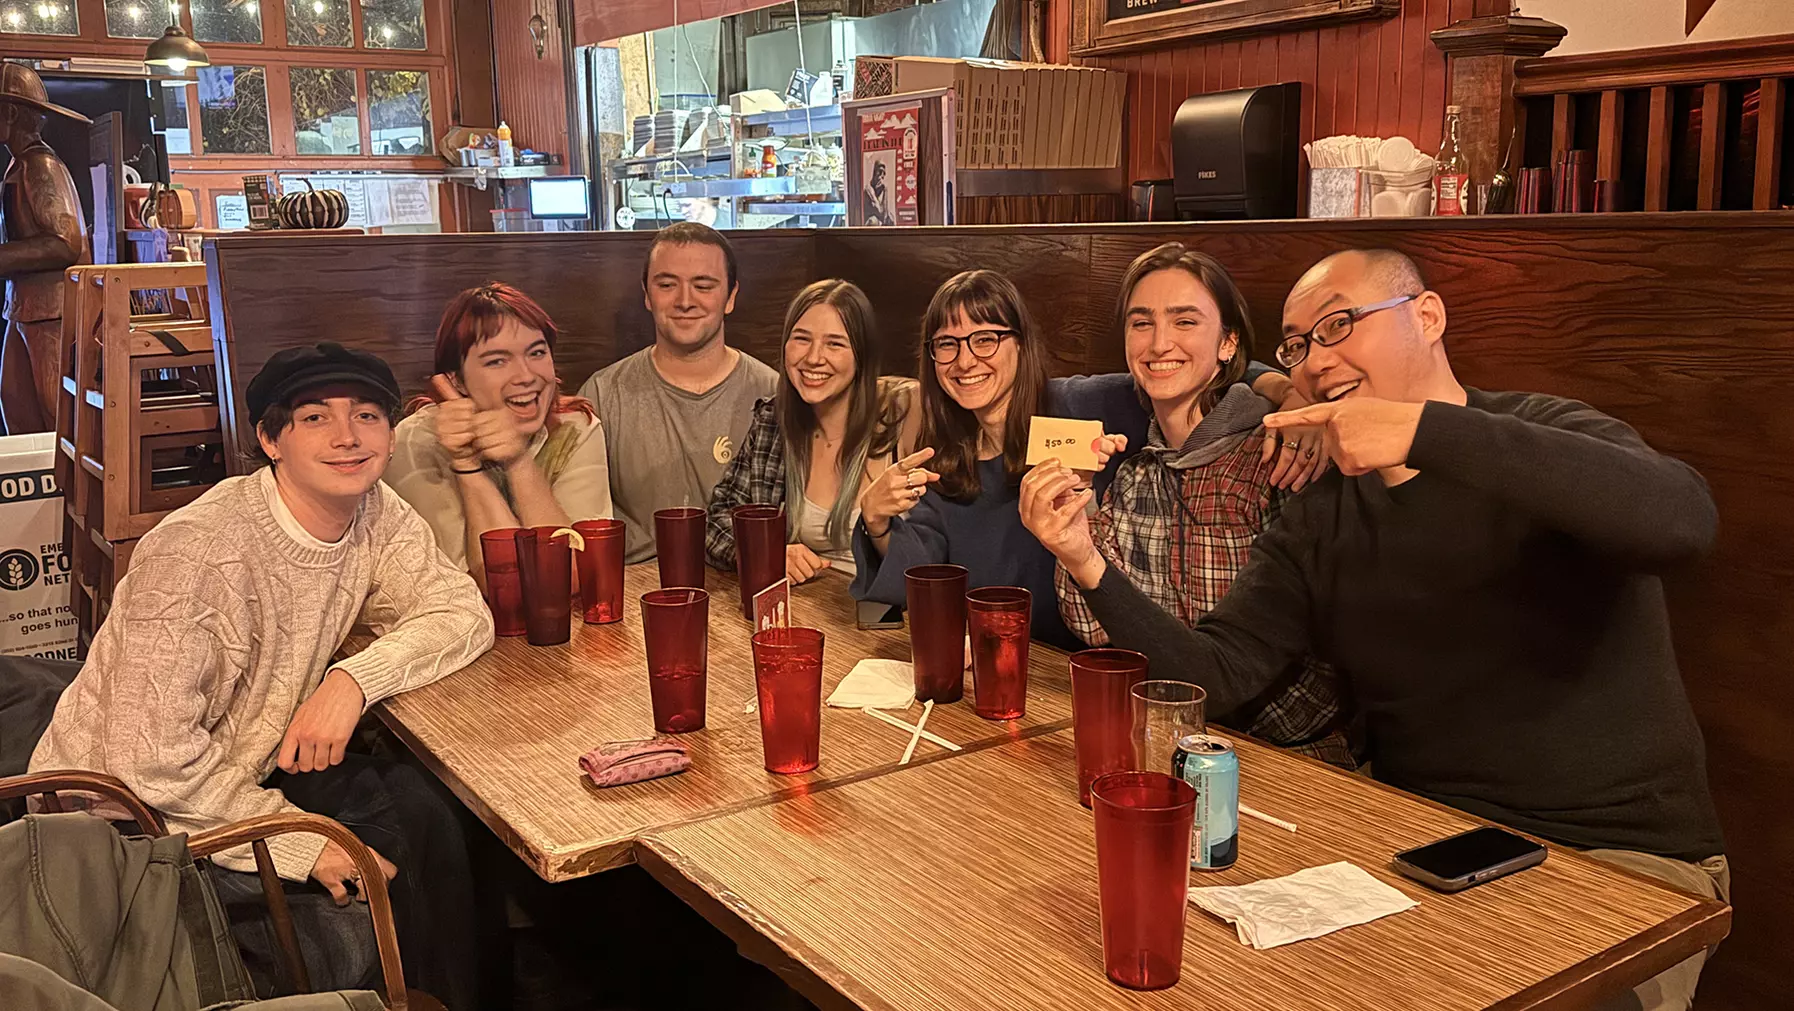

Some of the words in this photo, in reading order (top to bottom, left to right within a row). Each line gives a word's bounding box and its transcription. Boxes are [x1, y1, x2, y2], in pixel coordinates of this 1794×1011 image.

[41, 553, 72, 574] FO
[43, 573, 70, 586] NET
[28, 606, 52, 618] that
[55, 605, 71, 614] no
[21, 621, 51, 635] goes
[55, 617, 78, 628] hun
